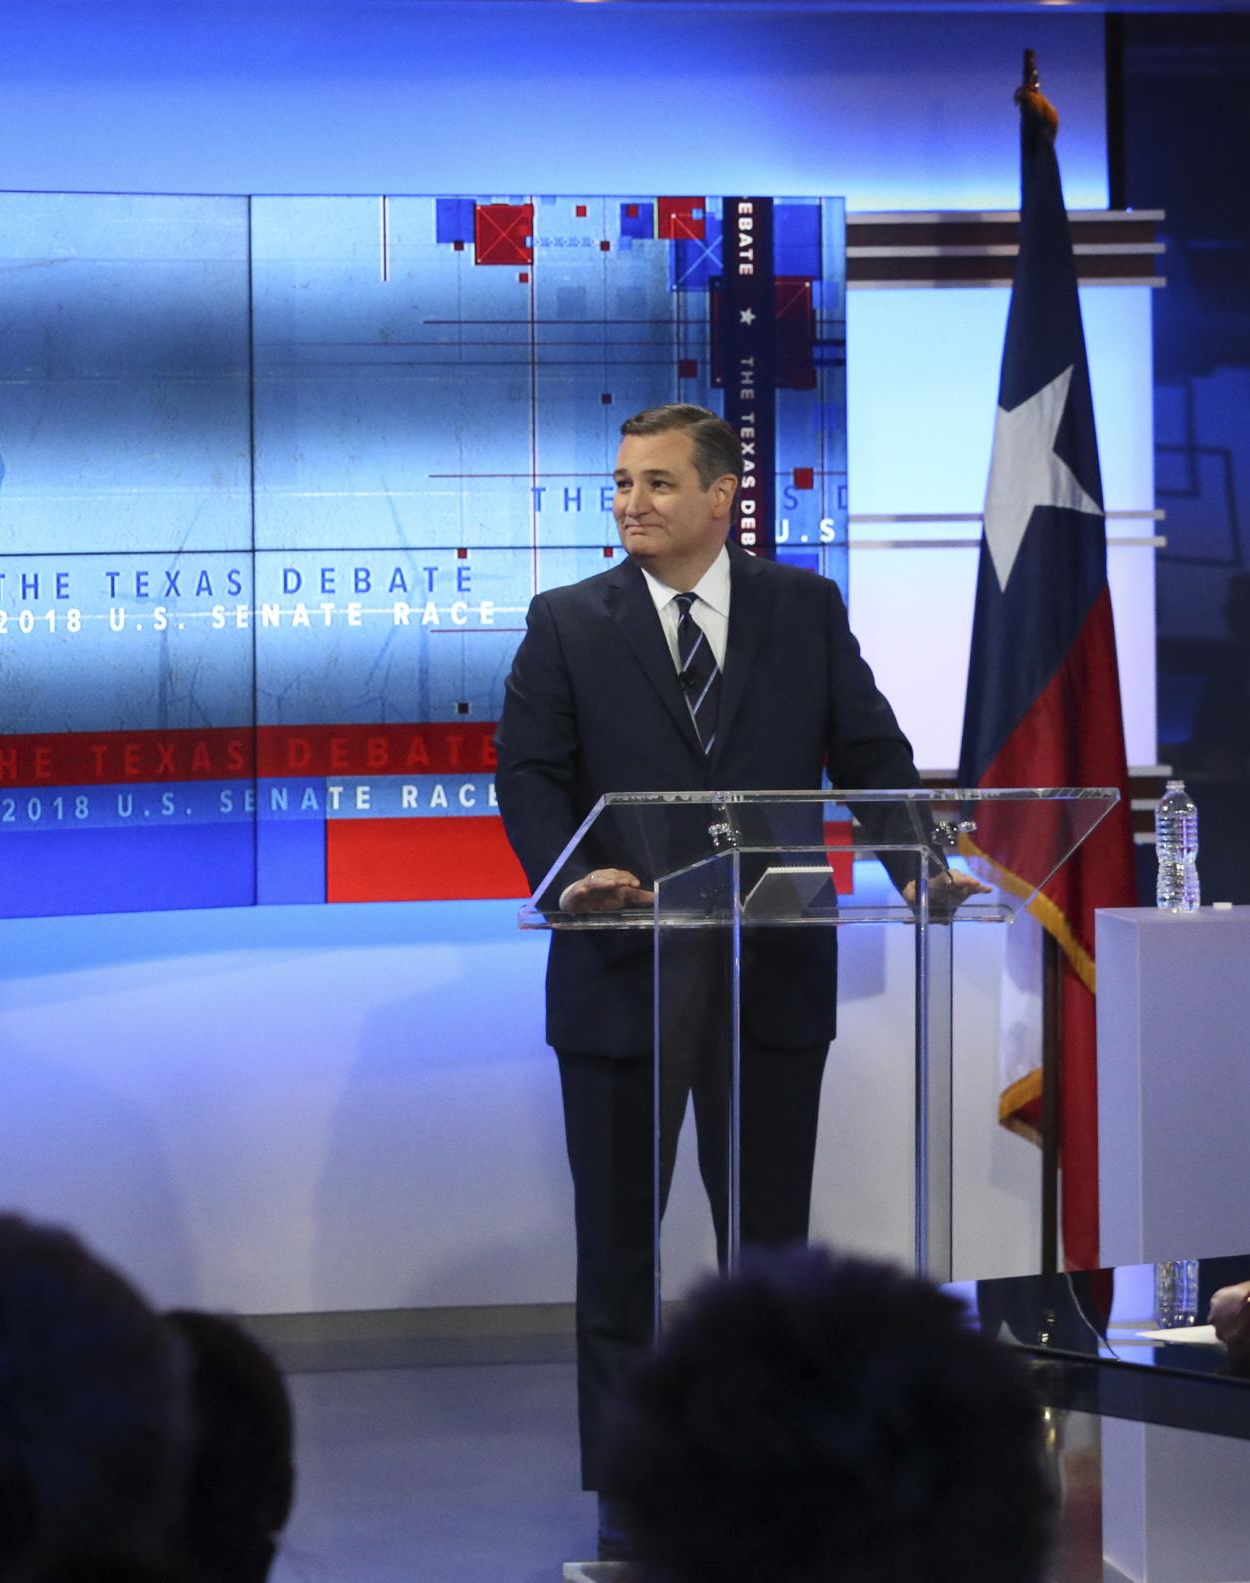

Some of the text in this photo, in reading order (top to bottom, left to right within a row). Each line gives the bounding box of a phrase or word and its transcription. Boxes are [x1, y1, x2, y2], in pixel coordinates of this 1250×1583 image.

[737, 196, 754, 275] EBATE
[740, 357, 757, 556] THE TEXAS DEB
[105, 568, 242, 598] TEXAS
[282, 566, 472, 594] DEBATE
[109, 606, 186, 632] U.S.
[211, 602, 363, 631] SENATE
[392, 600, 496, 627] RACE
[90, 738, 244, 777] TEXAS
[286, 733, 498, 770] DEBATE
[1, 794, 91, 822] 2018
[117, 790, 193, 818] U.S.
[219, 785, 372, 813] SENATE
